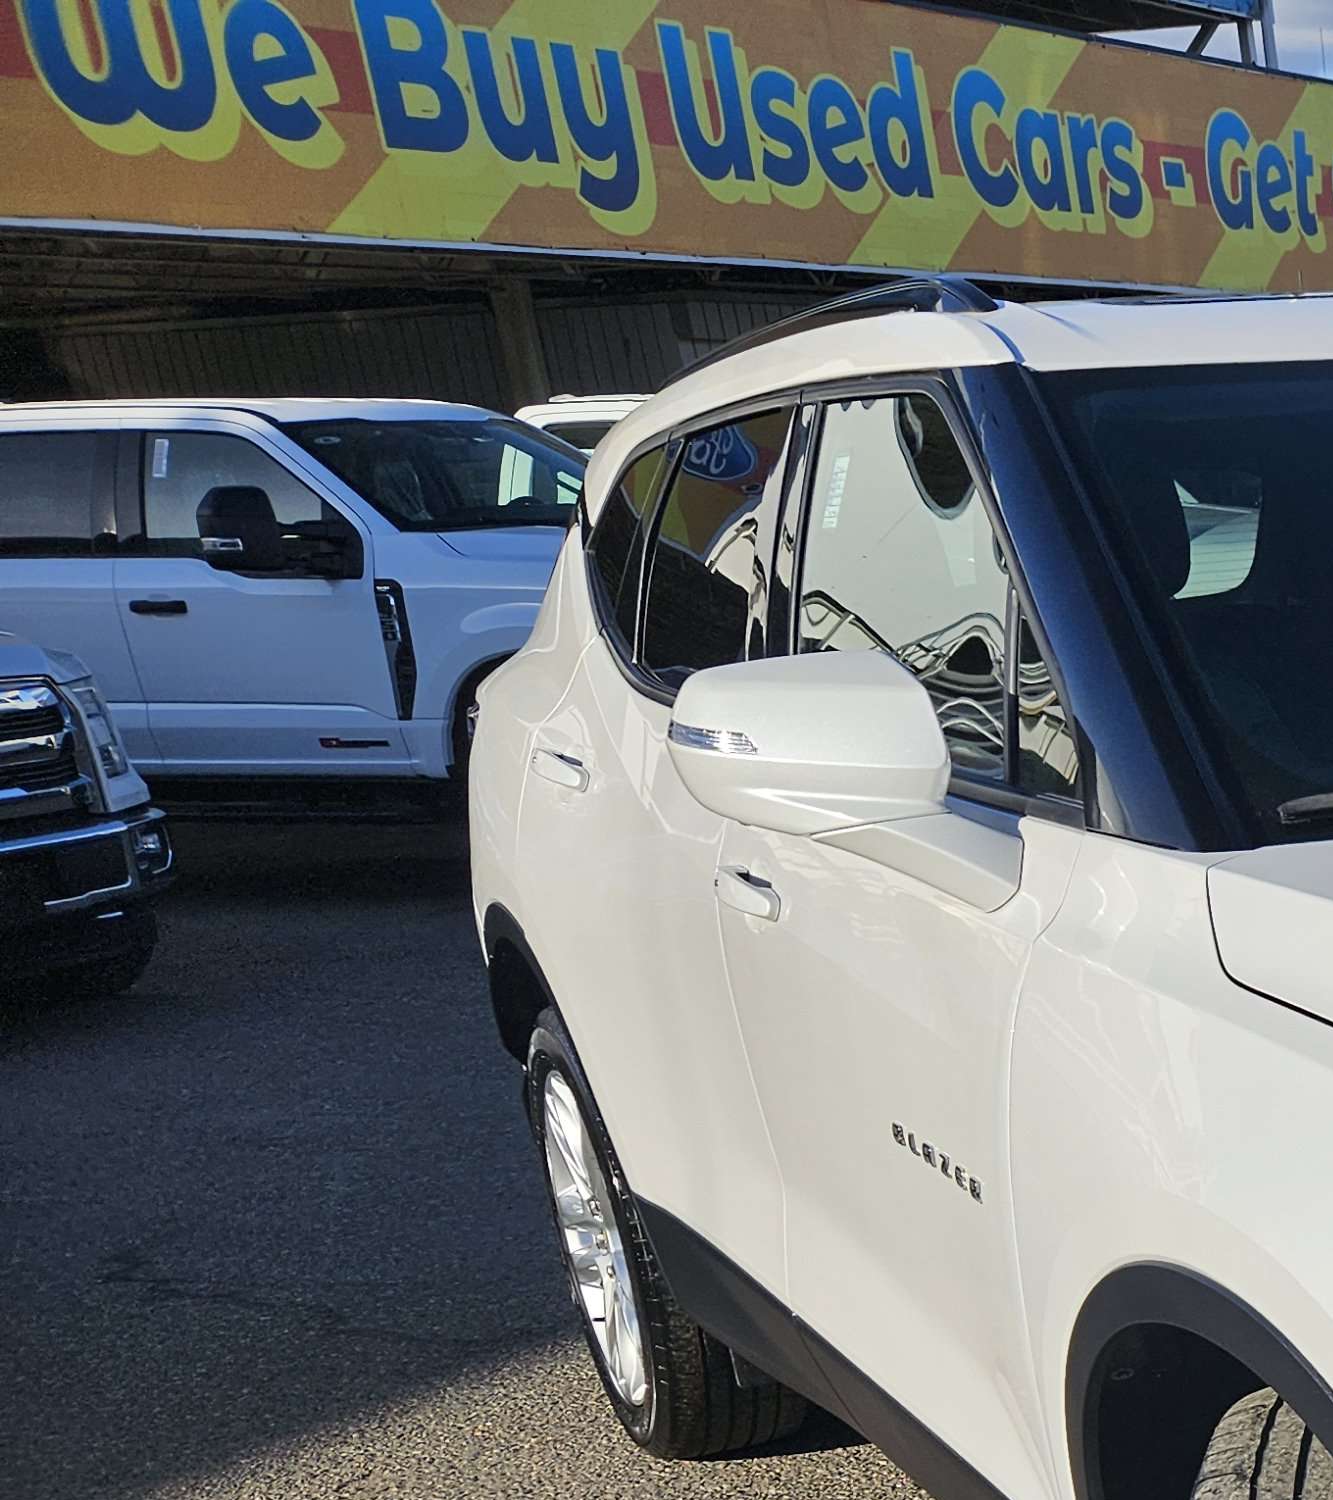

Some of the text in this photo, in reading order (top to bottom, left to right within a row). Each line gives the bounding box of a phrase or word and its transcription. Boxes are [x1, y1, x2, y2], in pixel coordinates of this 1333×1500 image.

[18, 0, 323, 142] We
[356, 0, 640, 212] Buy
[656, 23, 935, 199] Used
[953, 68, 1144, 220] Cars
[1206, 110, 1319, 237] Get
[891, 1121, 984, 1205] BLAZER
